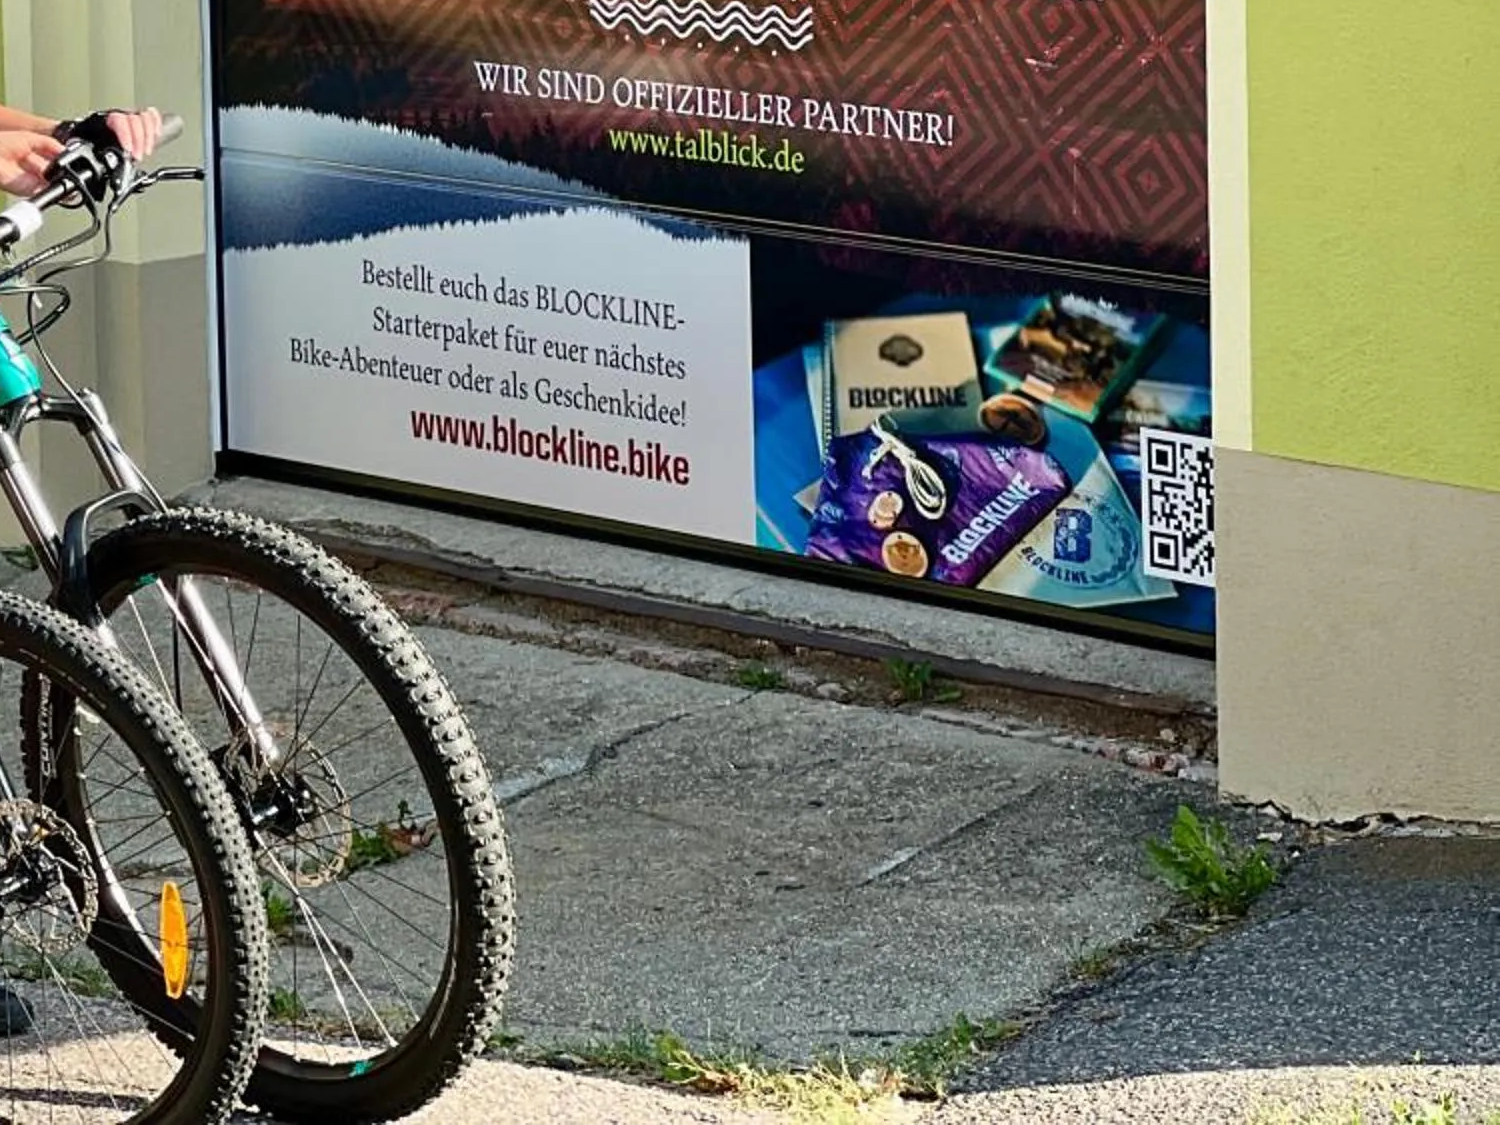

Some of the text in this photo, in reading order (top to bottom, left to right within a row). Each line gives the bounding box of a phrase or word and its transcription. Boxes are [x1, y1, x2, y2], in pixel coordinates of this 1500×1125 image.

[472, 60, 954, 147] WIR SIND OFFIZIELLER PARTNER!
[608, 127, 805, 174] www.talblick.de
[361, 259, 686, 331] Bestellt euch das BLOCKLINE-
[372, 305, 688, 381] Starterpaket für euer nächstes
[289, 337, 687, 428] Bike-Abenteuer oder als Geschenkidee!
[848, 386, 968, 409] BLOCKLINE
[410, 410, 691, 486] www.blockline.bike
[940, 471, 1042, 565] BLOCKLINE
